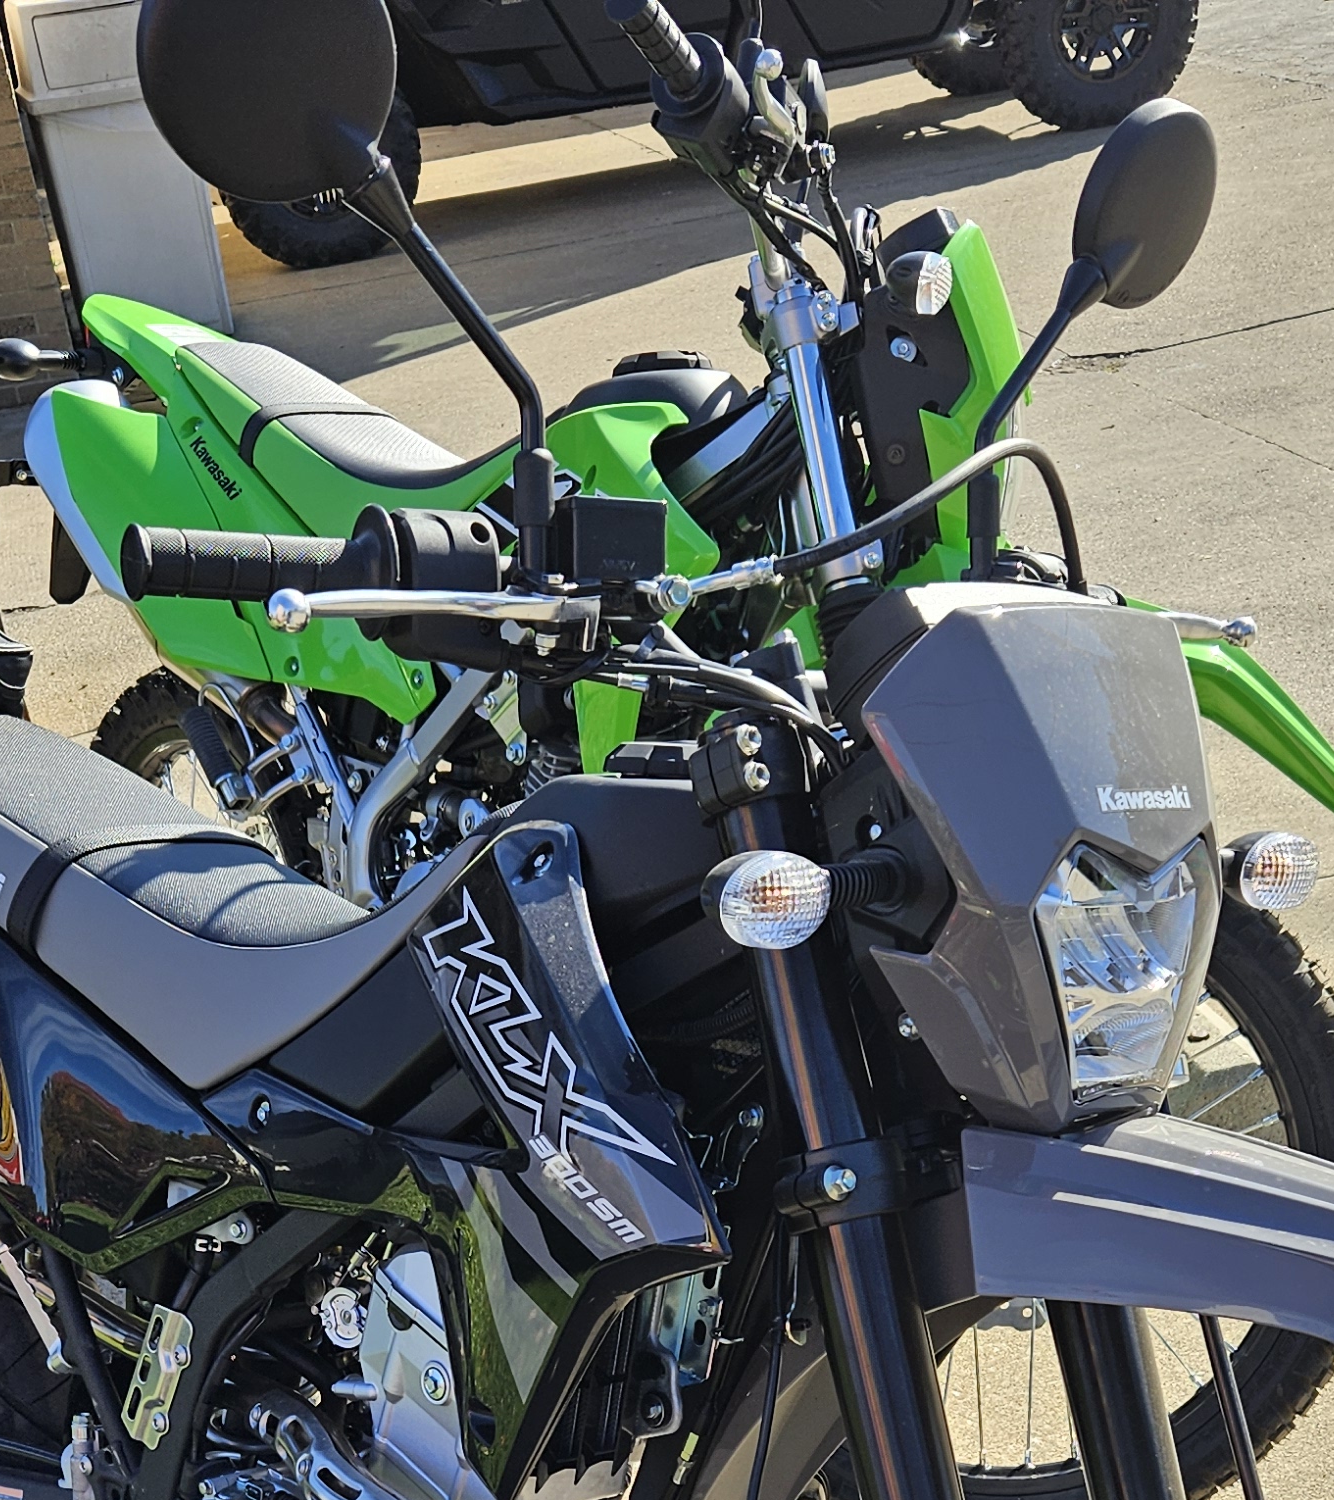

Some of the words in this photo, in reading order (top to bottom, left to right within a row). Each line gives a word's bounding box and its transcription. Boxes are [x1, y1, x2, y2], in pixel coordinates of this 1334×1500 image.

[189, 435, 243, 501] Kawasaki
[1096, 784, 1192, 812] Kawasaki
[421, 885, 679, 1167] KLX
